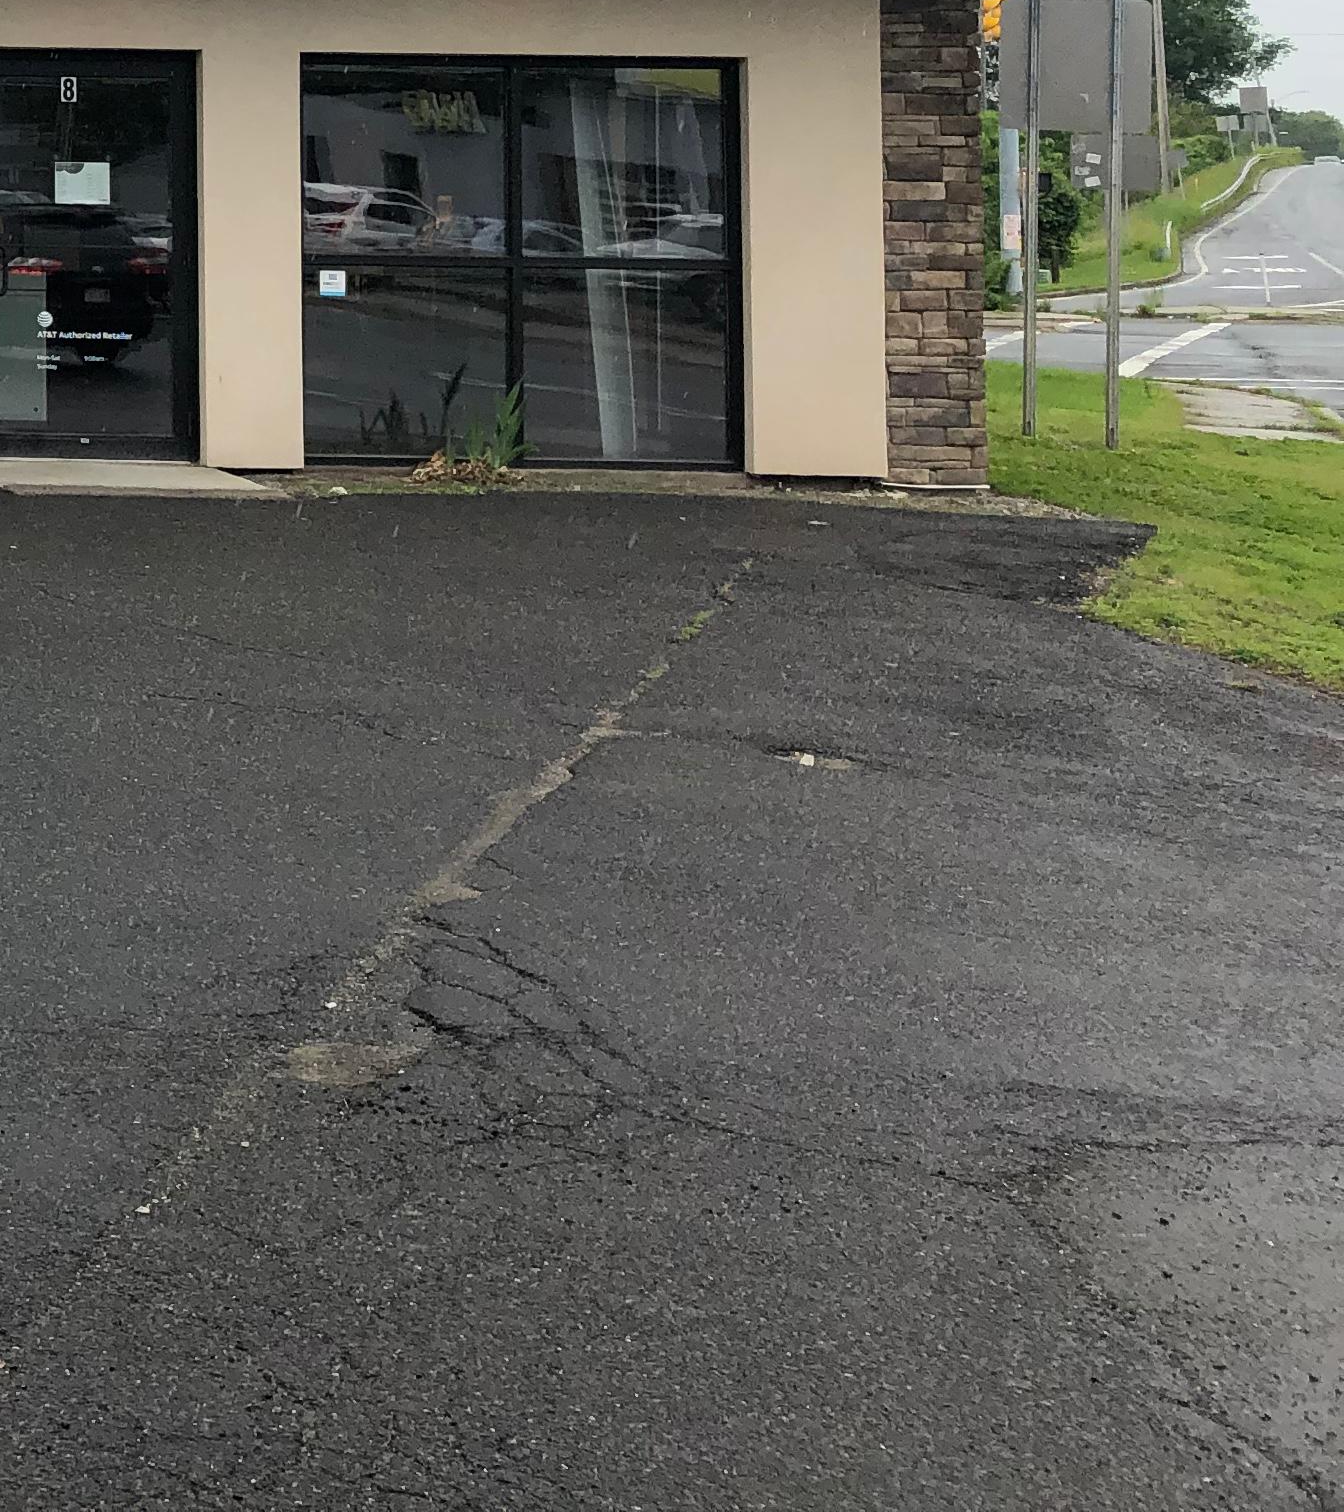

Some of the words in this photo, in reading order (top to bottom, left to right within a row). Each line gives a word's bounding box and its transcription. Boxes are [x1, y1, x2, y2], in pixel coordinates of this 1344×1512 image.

[63, 78, 75, 101] 8
[37, 330, 58, 339] AT&T
[59, 331, 102, 340] Authorized
[102, 332, 133, 341] Retailer
